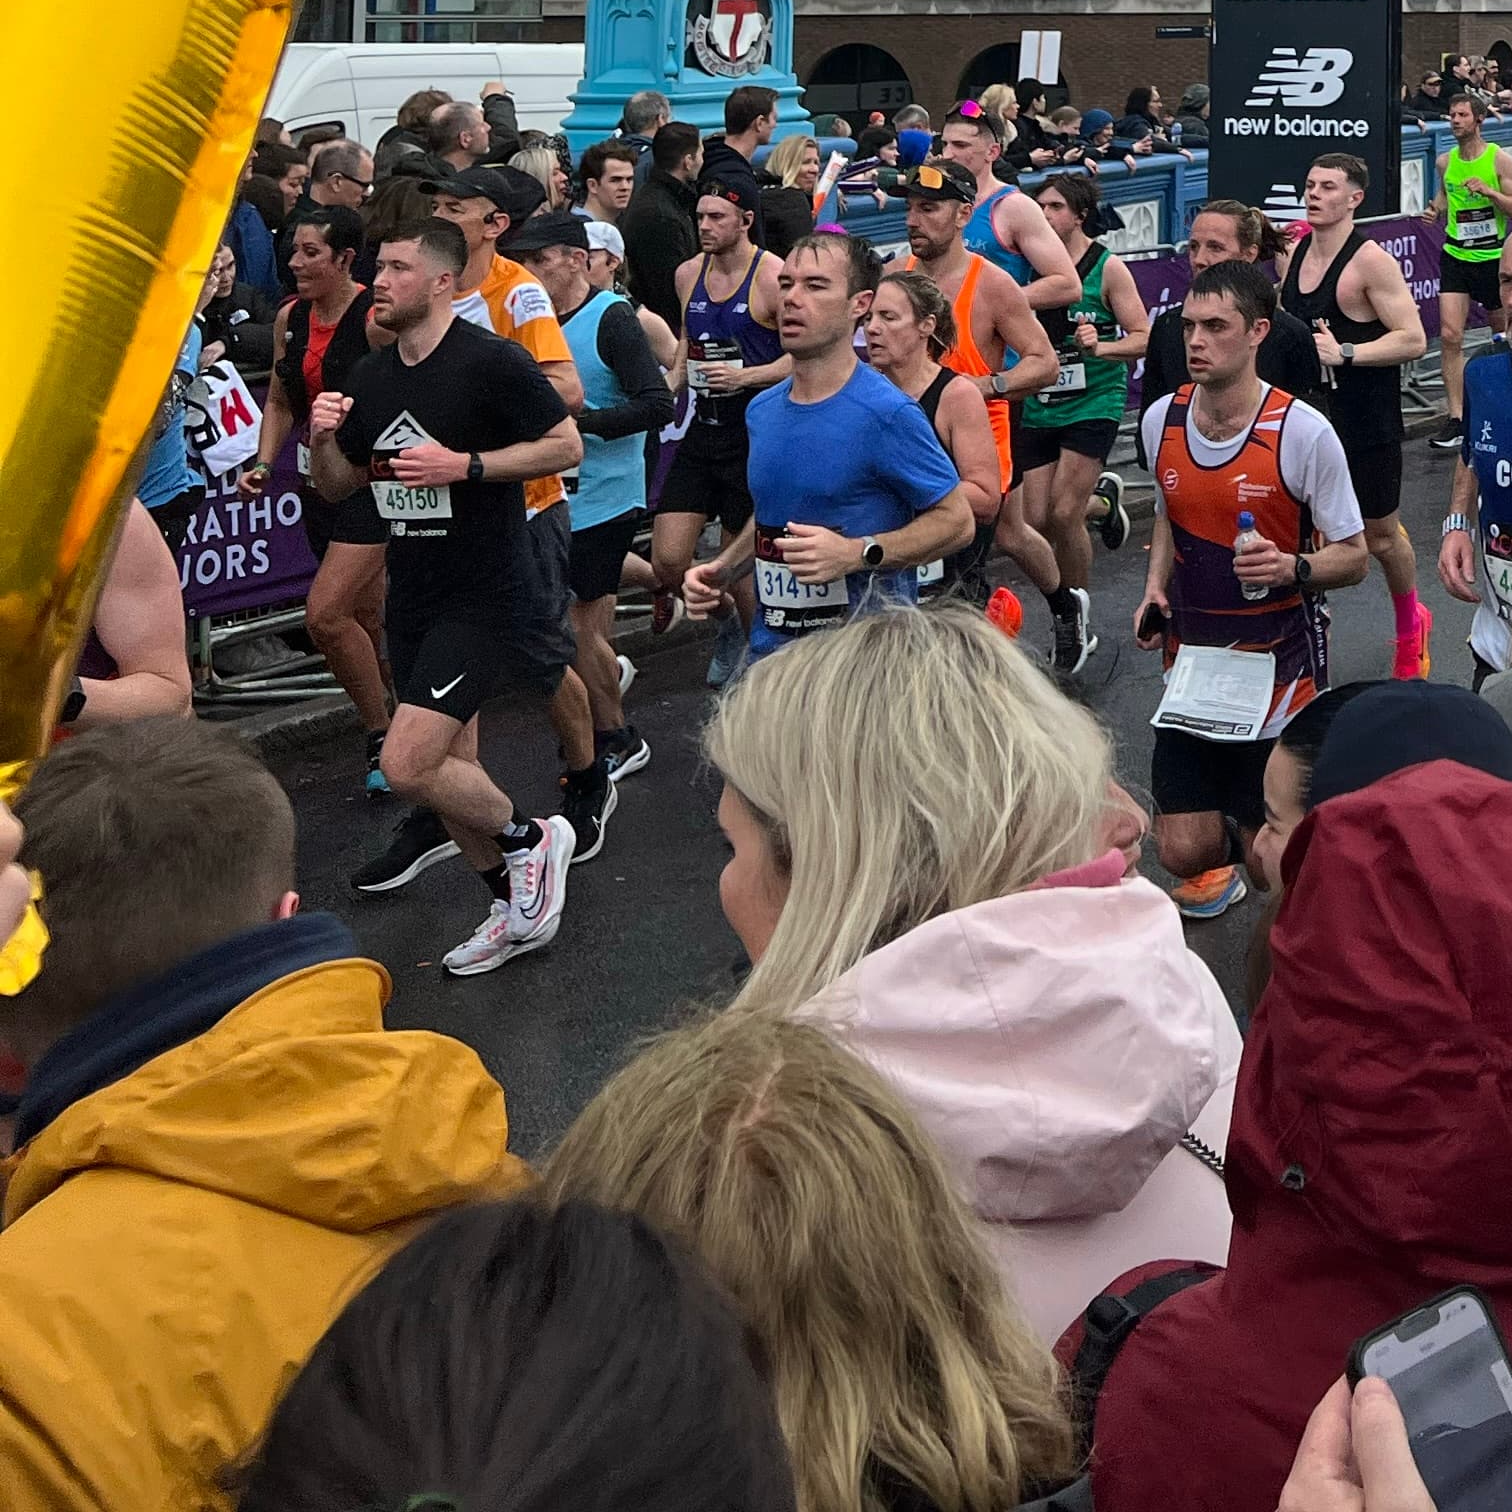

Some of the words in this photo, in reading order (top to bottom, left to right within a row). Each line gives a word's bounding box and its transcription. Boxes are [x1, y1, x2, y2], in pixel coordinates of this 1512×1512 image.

[1224, 117, 1270, 136] new
[1274, 114, 1369, 138] balance
[386, 487, 439, 511] 45150
